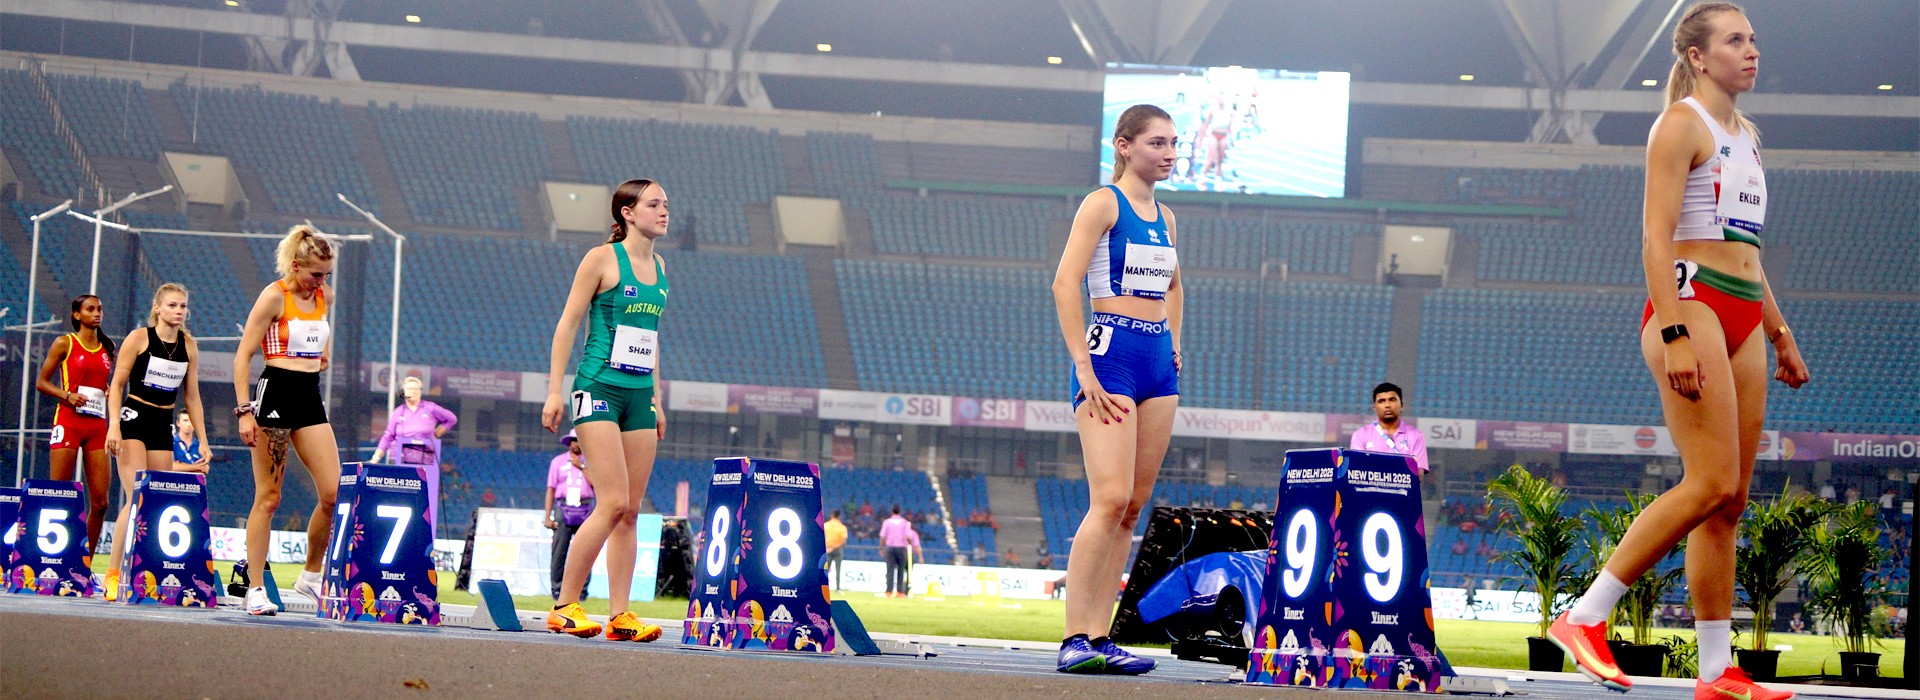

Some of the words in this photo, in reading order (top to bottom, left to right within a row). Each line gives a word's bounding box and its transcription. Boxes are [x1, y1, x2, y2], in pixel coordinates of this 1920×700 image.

[1739, 191, 1761, 206] EKLER
[1093, 314, 1130, 328] NIKE
[1131, 320, 1162, 334] PRO
[1088, 325, 1104, 351] 8
[628, 345, 652, 356] SHARP
[574, 392, 584, 417] 7
[907, 398, 942, 417] SBI
[981, 400, 1017, 421] SBI
[122, 409, 132, 418] 5
[1180, 411, 1262, 435] Welspun
[1268, 420, 1323, 434] WORLD
[53, 428, 60, 441] 4
[1430, 424, 1462, 440] SAI
[713, 473, 722, 481] NEW
[754, 472, 772, 480] NEW
[773, 474, 795, 483] DELHI
[796, 476, 814, 485] 2025
[1287, 469, 1302, 479] NEW
[1302, 469, 1320, 478] DELHI
[1320, 467, 1334, 477] 2025
[1347, 469, 1367, 480] NEW
[1368, 471, 1392, 482] DELHI
[1393, 473, 1411, 484] 2025
[149, 481, 166, 489] NEW
[166, 482, 185, 490] DELHI
[366, 476, 384, 484] NEW
[384, 478, 405, 486] DELHI
[405, 479, 422, 487] 2025
[36, 508, 69, 555] 5
[158, 505, 191, 558] 6
[376, 504, 412, 565] 7
[706, 505, 730, 577] 8
[765, 507, 803, 580] 8
[40, 556, 63, 565] Vinex
[1283, 508, 1318, 598] 9
[1362, 512, 1404, 602] 9
[163, 560, 186, 570] Vinex
[381, 570, 406, 581] Vinex
[845, 570, 872, 583] SAI
[705, 583, 719, 595] Vinex
[1001, 577, 1028, 590] SAI
[771, 585, 798, 598] Vinex
[1283, 606, 1305, 621] Vinex
[1370, 611, 1399, 625] Vinex
